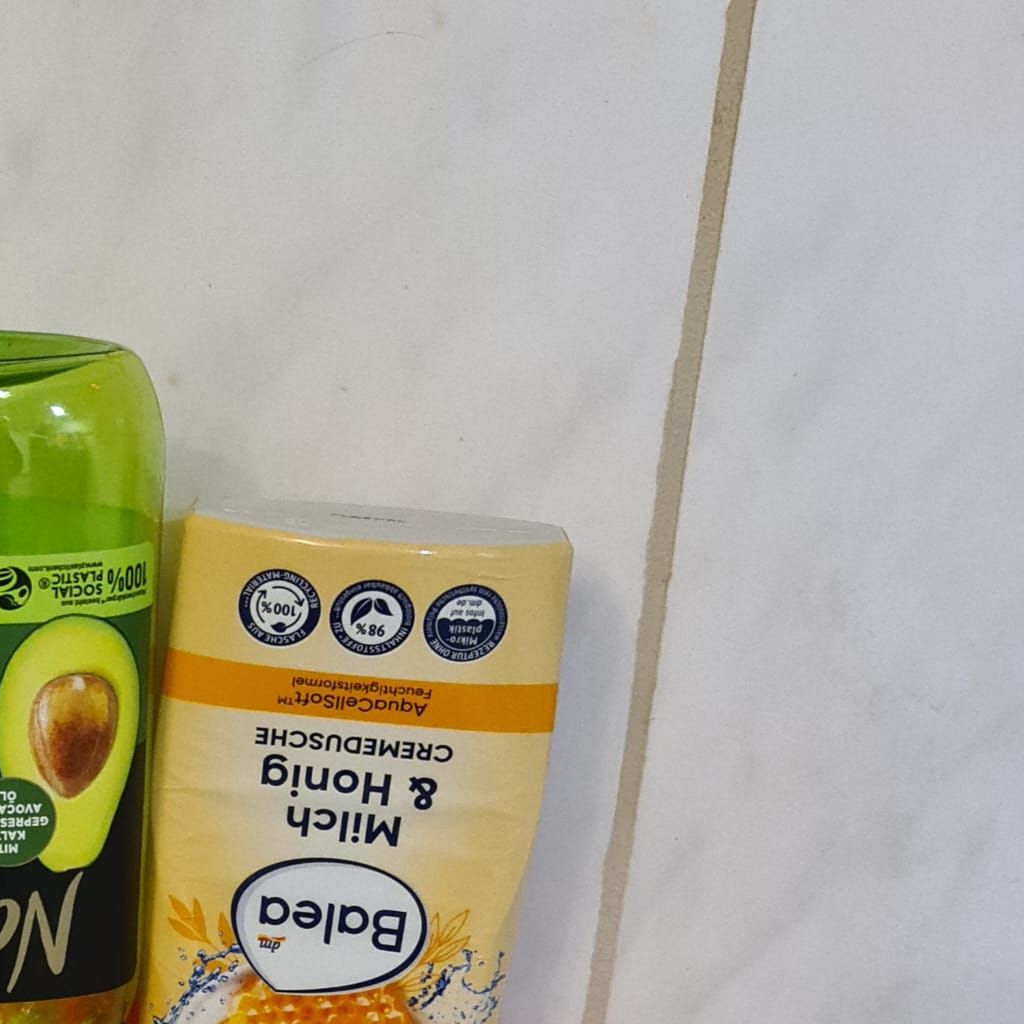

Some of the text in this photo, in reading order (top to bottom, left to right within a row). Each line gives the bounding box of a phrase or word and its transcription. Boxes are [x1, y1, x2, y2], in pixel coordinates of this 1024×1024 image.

[107, 561, 147, 594] 100%
[51, 583, 104, 600] SOCIAL
[450, 610, 485, 618] Infos auf
[456, 600, 483, 608] dm.de
[246, 622, 307, 645] FLASCHE AUS
[449, 624, 483, 635] plastik
[429, 638, 496, 660] REZEPTUR OHNE
[291, 677, 433, 700] Feuchtigkeitsformel
[255, 727, 454, 763] CREMEDUSCHE
[260, 754, 438, 811] & Honig
[0, 791, 17, 804] ÖL
[287, 806, 402, 848] Milch
[258, 895, 408, 953] Balea
[259, 940, 281, 953] dm
